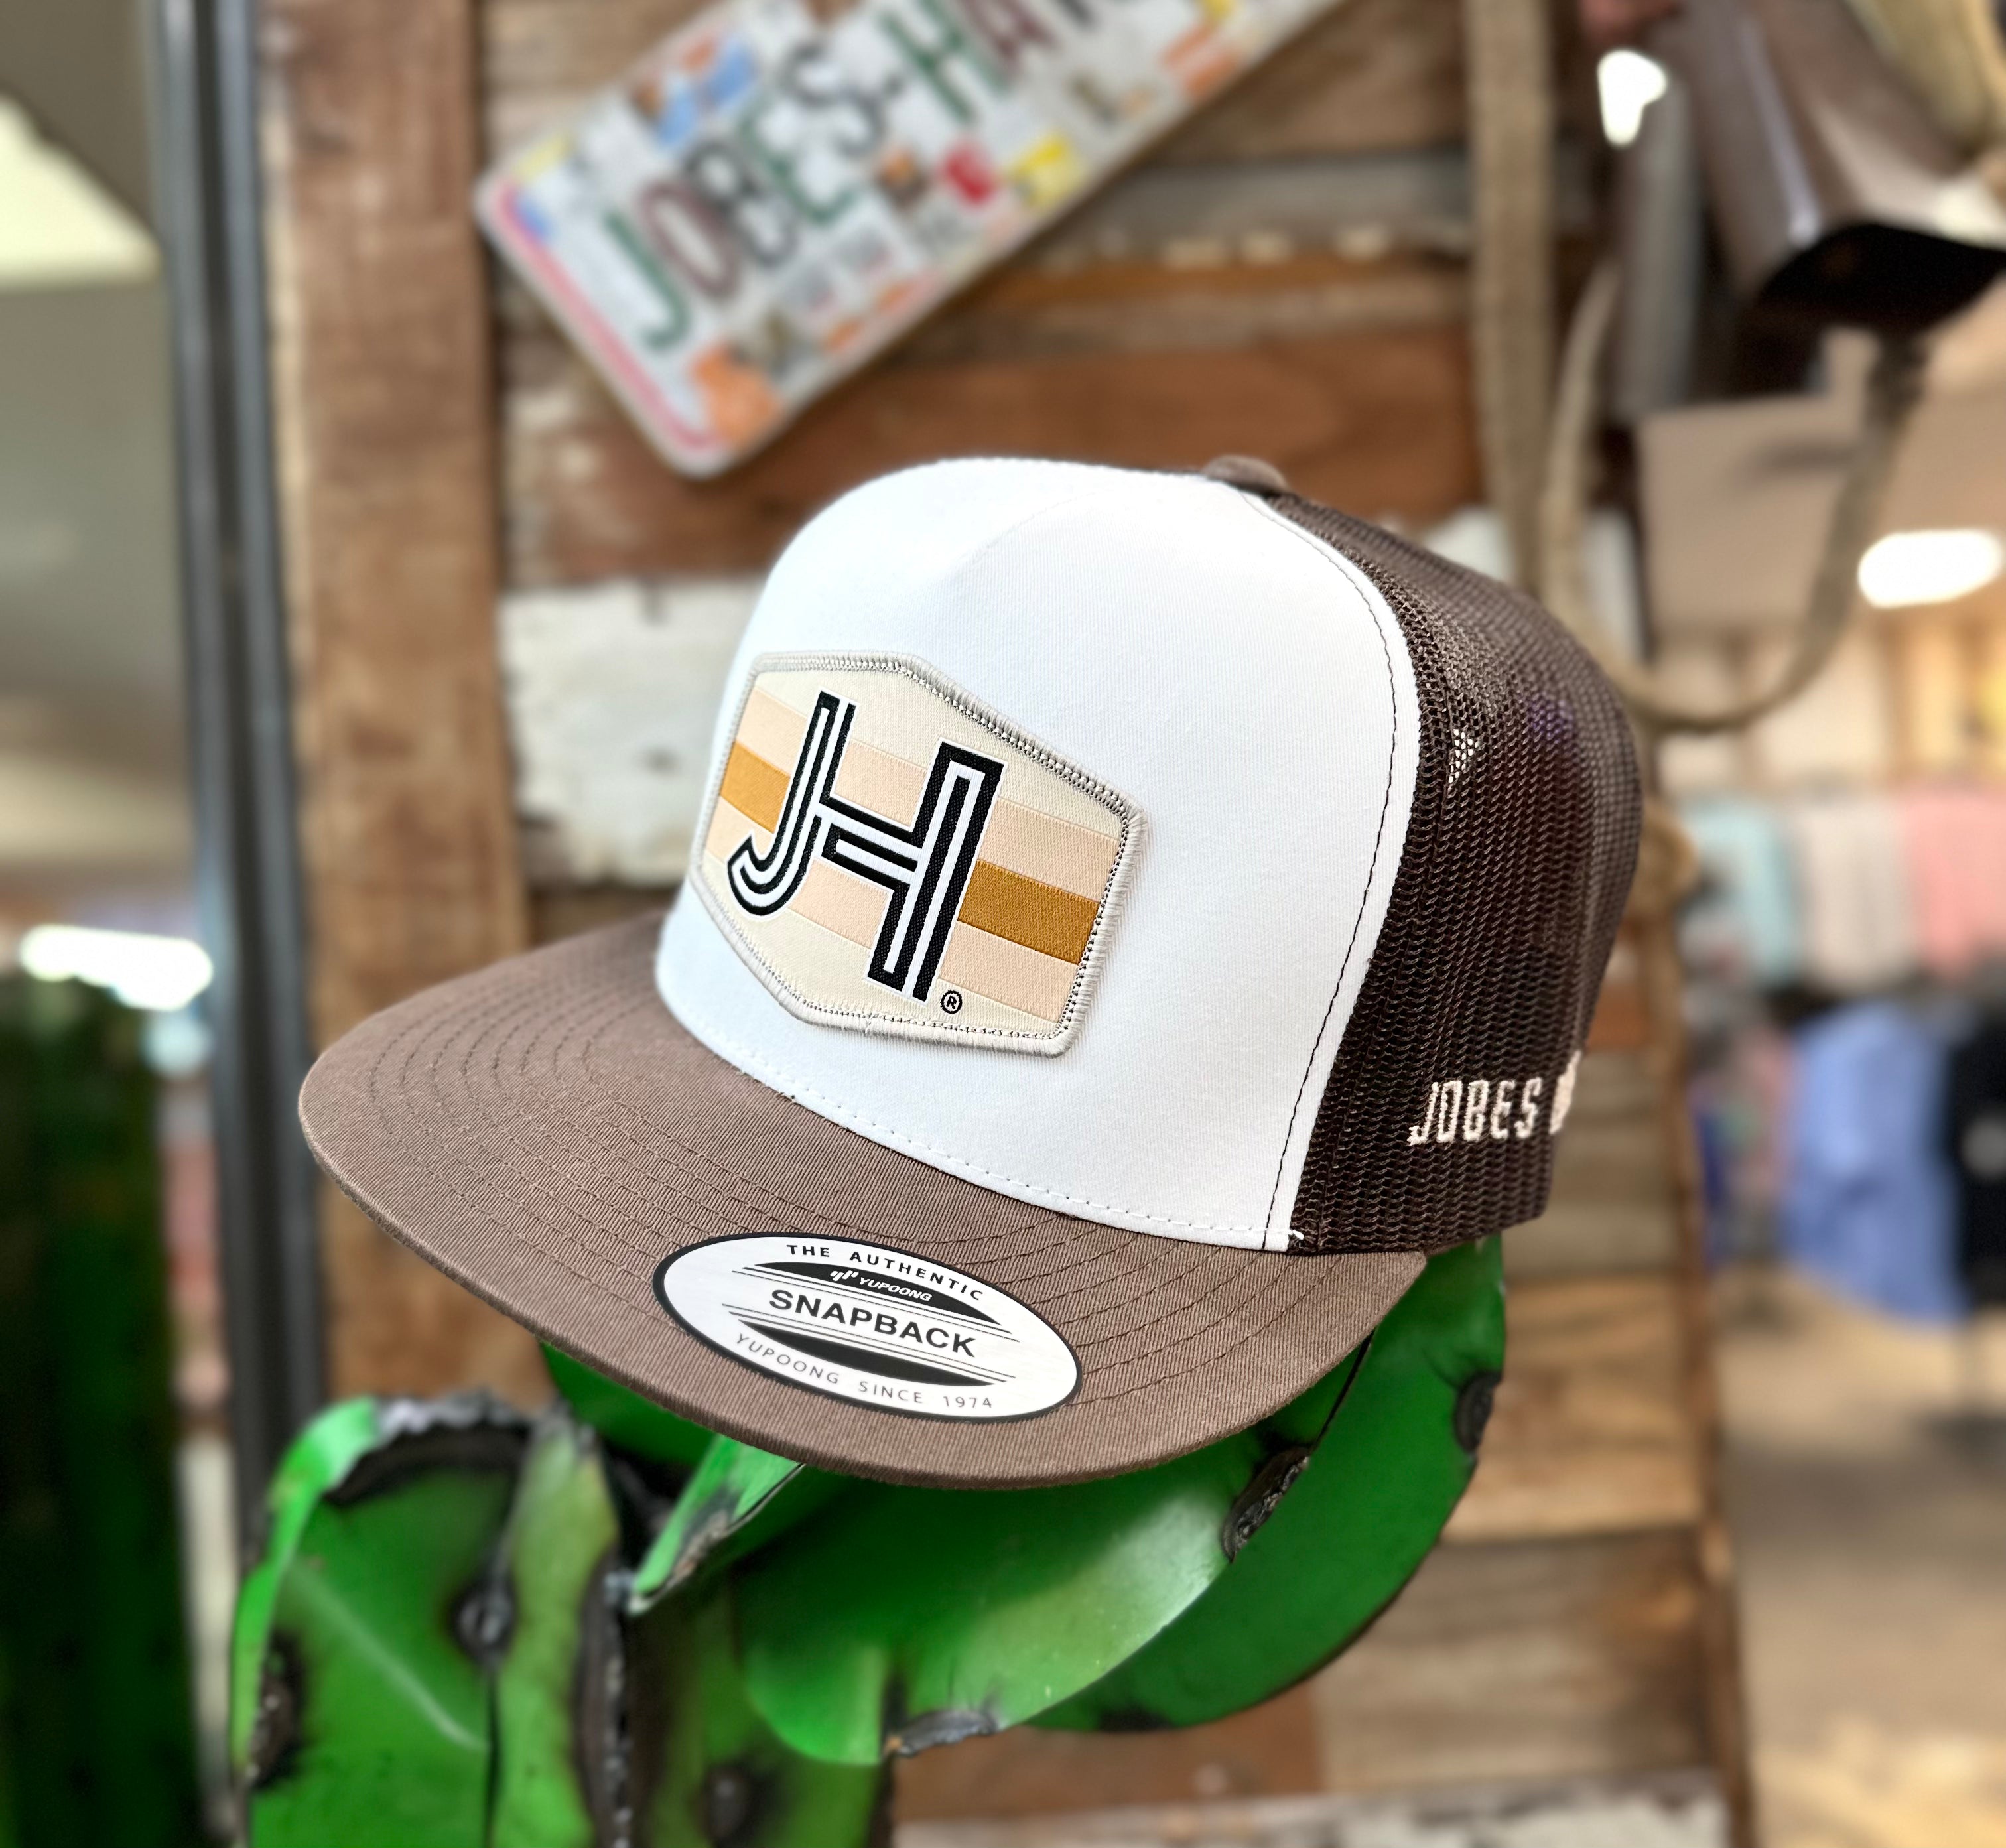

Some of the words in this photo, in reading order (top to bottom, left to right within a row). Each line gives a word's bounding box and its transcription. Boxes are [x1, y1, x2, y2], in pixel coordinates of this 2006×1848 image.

[1406, 1077, 1543, 1146] JOBES
[787, 1244, 831, 1258] THE
[849, 1251, 983, 1301] AUTHENTIC
[858, 1276, 933, 1302] YUPOONG
[769, 1289, 976, 1358] SNAPBACK
[736, 1333, 839, 1384] YUPOONG
[858, 1380, 923, 1403] SINCE
[943, 1396, 993, 1409] 1974
